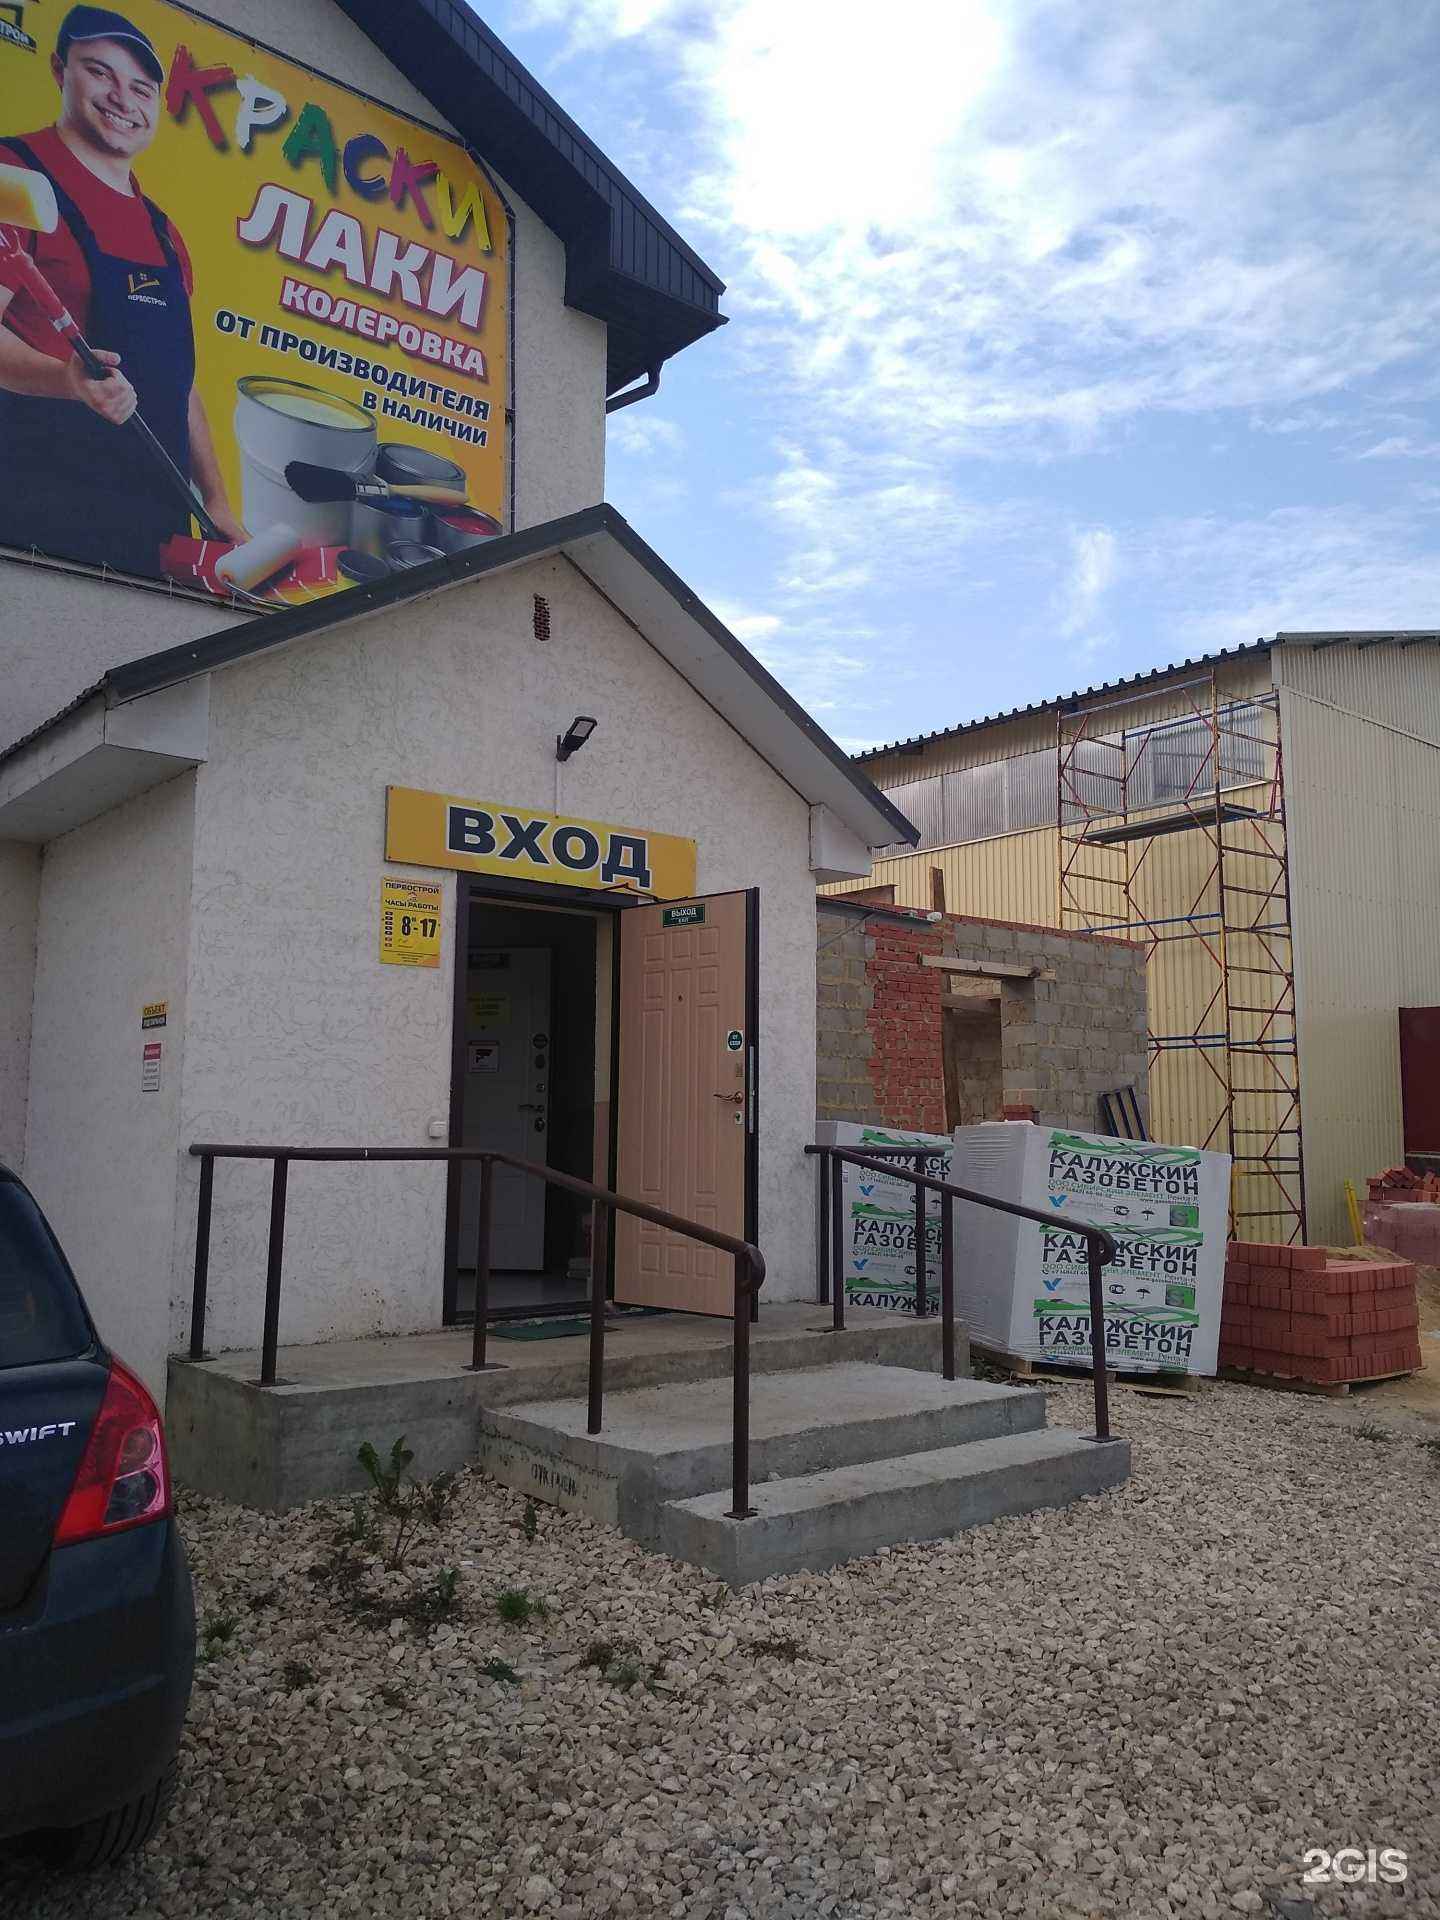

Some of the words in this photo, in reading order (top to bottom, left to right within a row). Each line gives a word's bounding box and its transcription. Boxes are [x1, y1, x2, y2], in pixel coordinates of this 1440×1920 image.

[166, 43, 493, 252] КРАСКИ
[237, 183, 489, 329] ЛАКИ
[280, 276, 486, 380] КОЛЕРОВКА
[215, 310, 255, 339] ОТ
[260, 324, 490, 421] ПРОИЗВОДИТЕЛЯ
[362, 390, 378, 411] В
[381, 397, 488, 447] НАЛИЧИИ
[448, 806, 651, 888] ВХОД
[385, 882, 440, 894] ПЕРВОСТРОЙ
[385, 899, 407, 908] ЧАСЫ
[408, 901, 439, 911] РАБОТЫ
[671, 907, 697, 918] ВЫХОД
[1049, 1164, 1199, 1195] ГАЗОБЕТОН
[1050, 1150, 1199, 1181] КАЛУЖСКИЙ
[1043, 1249, 1197, 1277] ГАЗБЕТОН
[1044, 1233, 1198, 1262] КАЛЖСКИЙ
[1039, 1316, 1193, 1345] КАЛЖСКИЙ
[1039, 1331, 1191, 1357] ГАЗБЕТОН
